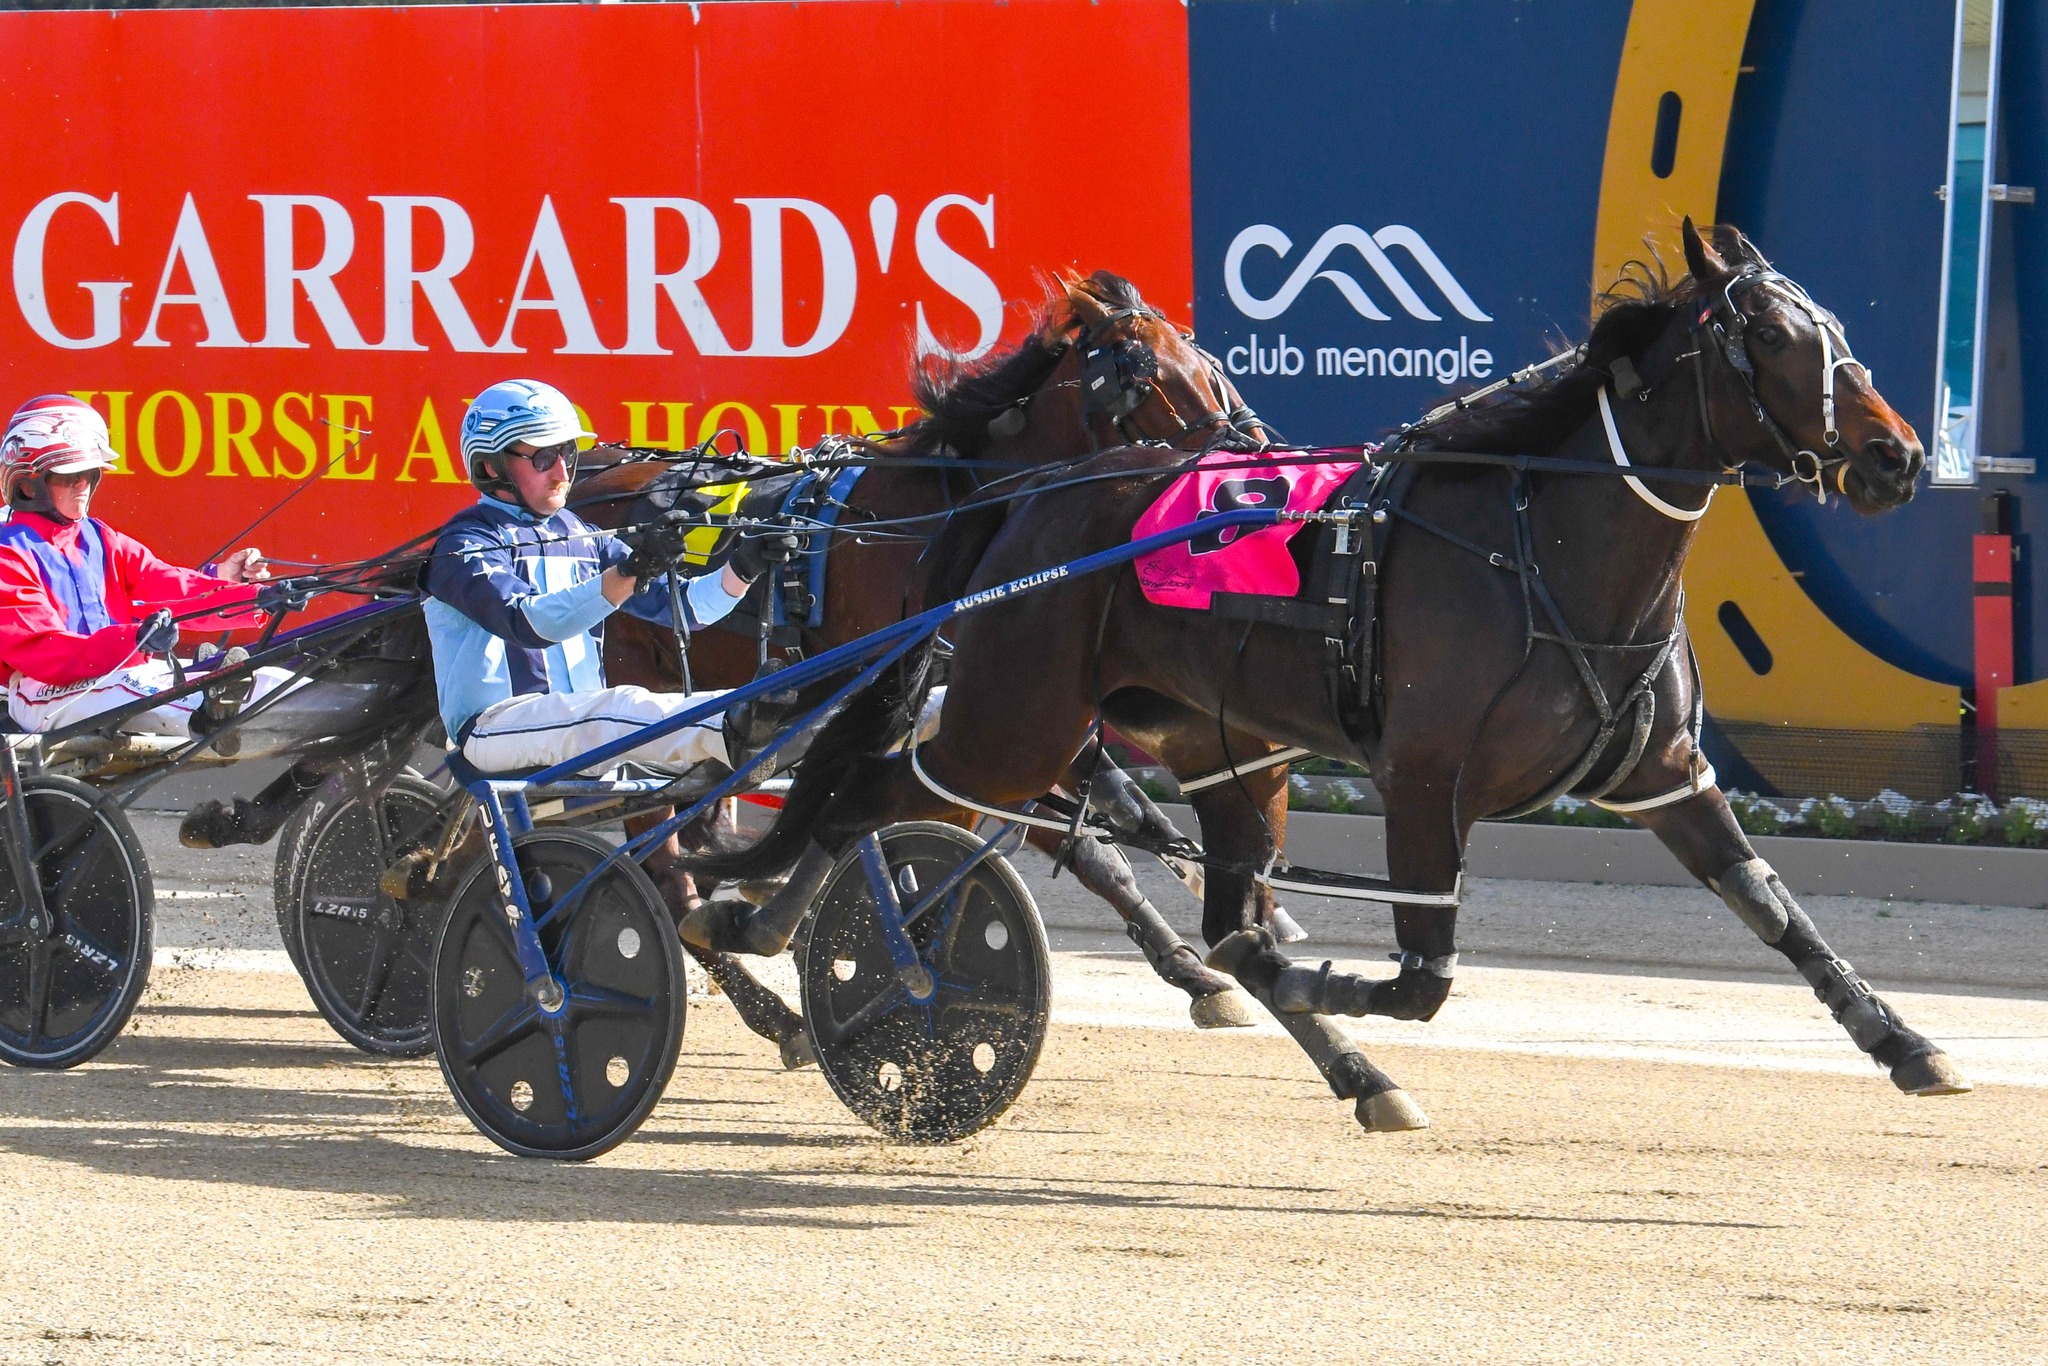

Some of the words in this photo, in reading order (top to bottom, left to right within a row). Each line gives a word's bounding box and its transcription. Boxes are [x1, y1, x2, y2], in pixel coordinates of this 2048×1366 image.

[12, 191, 1003, 363] GARRARD'S
[1227, 334, 1305, 377] club
[1317, 336, 1493, 385] menangle
[67, 390, 377, 482] HORSE
[683, 480, 752, 566] 7
[953, 582, 1007, 613] AUSSIE
[1010, 564, 1069, 596] ECLIPSE
